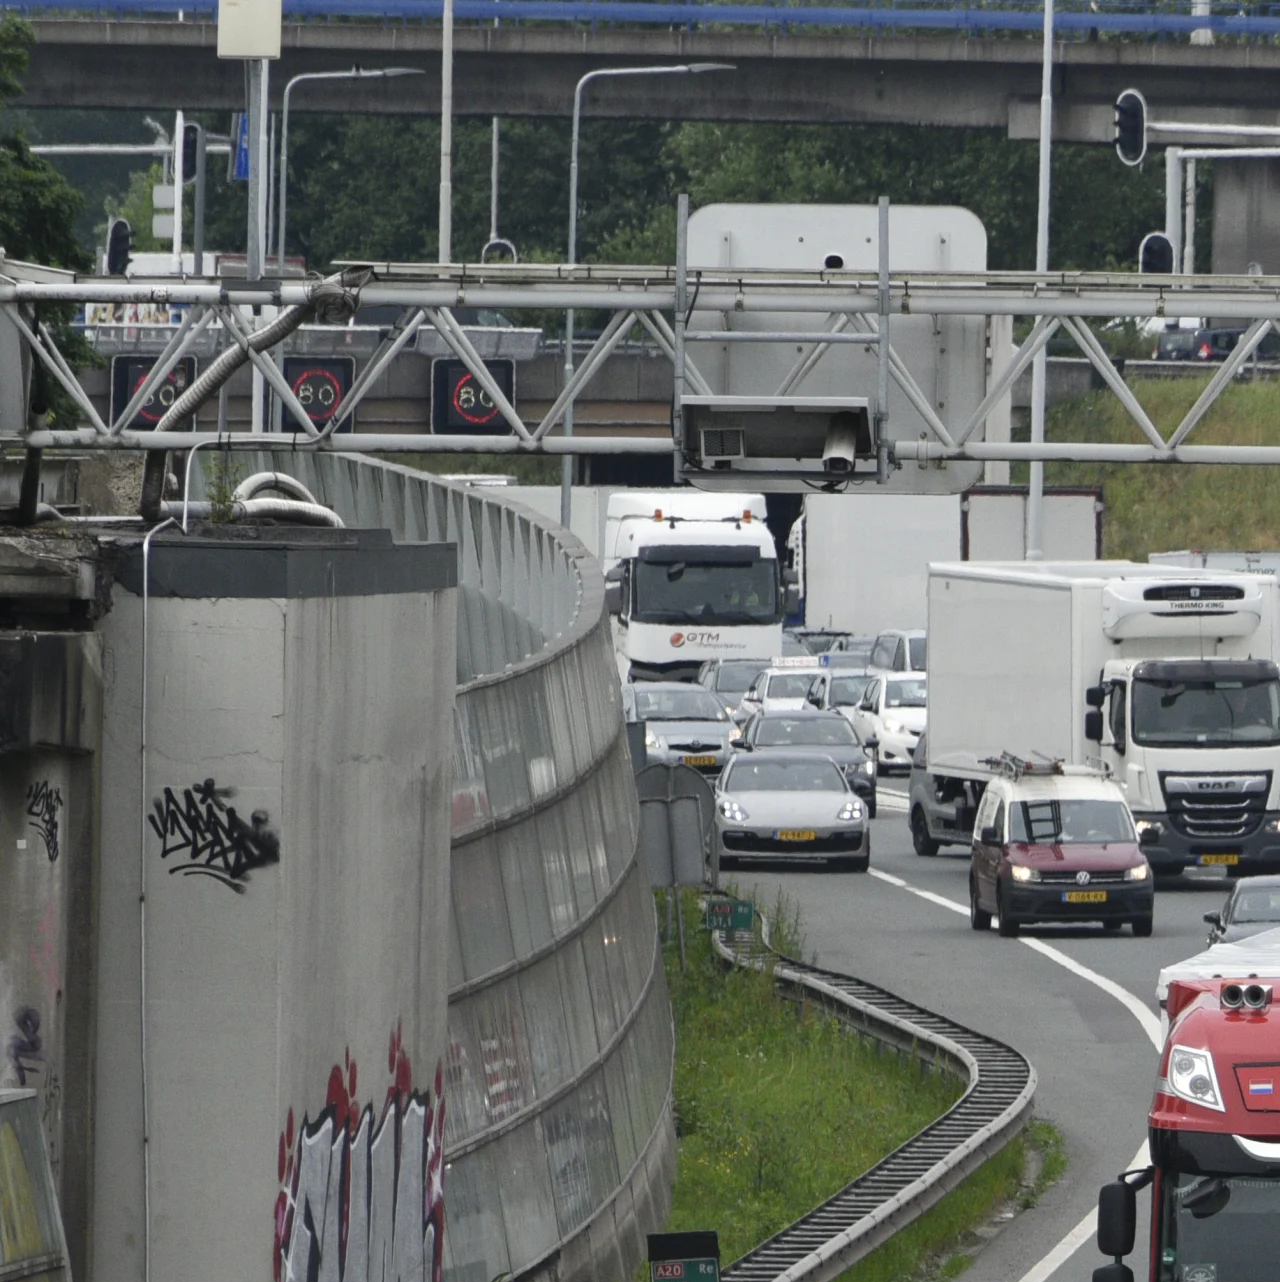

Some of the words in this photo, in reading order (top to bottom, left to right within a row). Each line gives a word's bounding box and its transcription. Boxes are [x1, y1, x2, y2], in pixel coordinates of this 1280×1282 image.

[298, 385, 334, 406] 80
[657, 1265, 681, 1277] A20
[699, 1263, 713, 1274] Re
